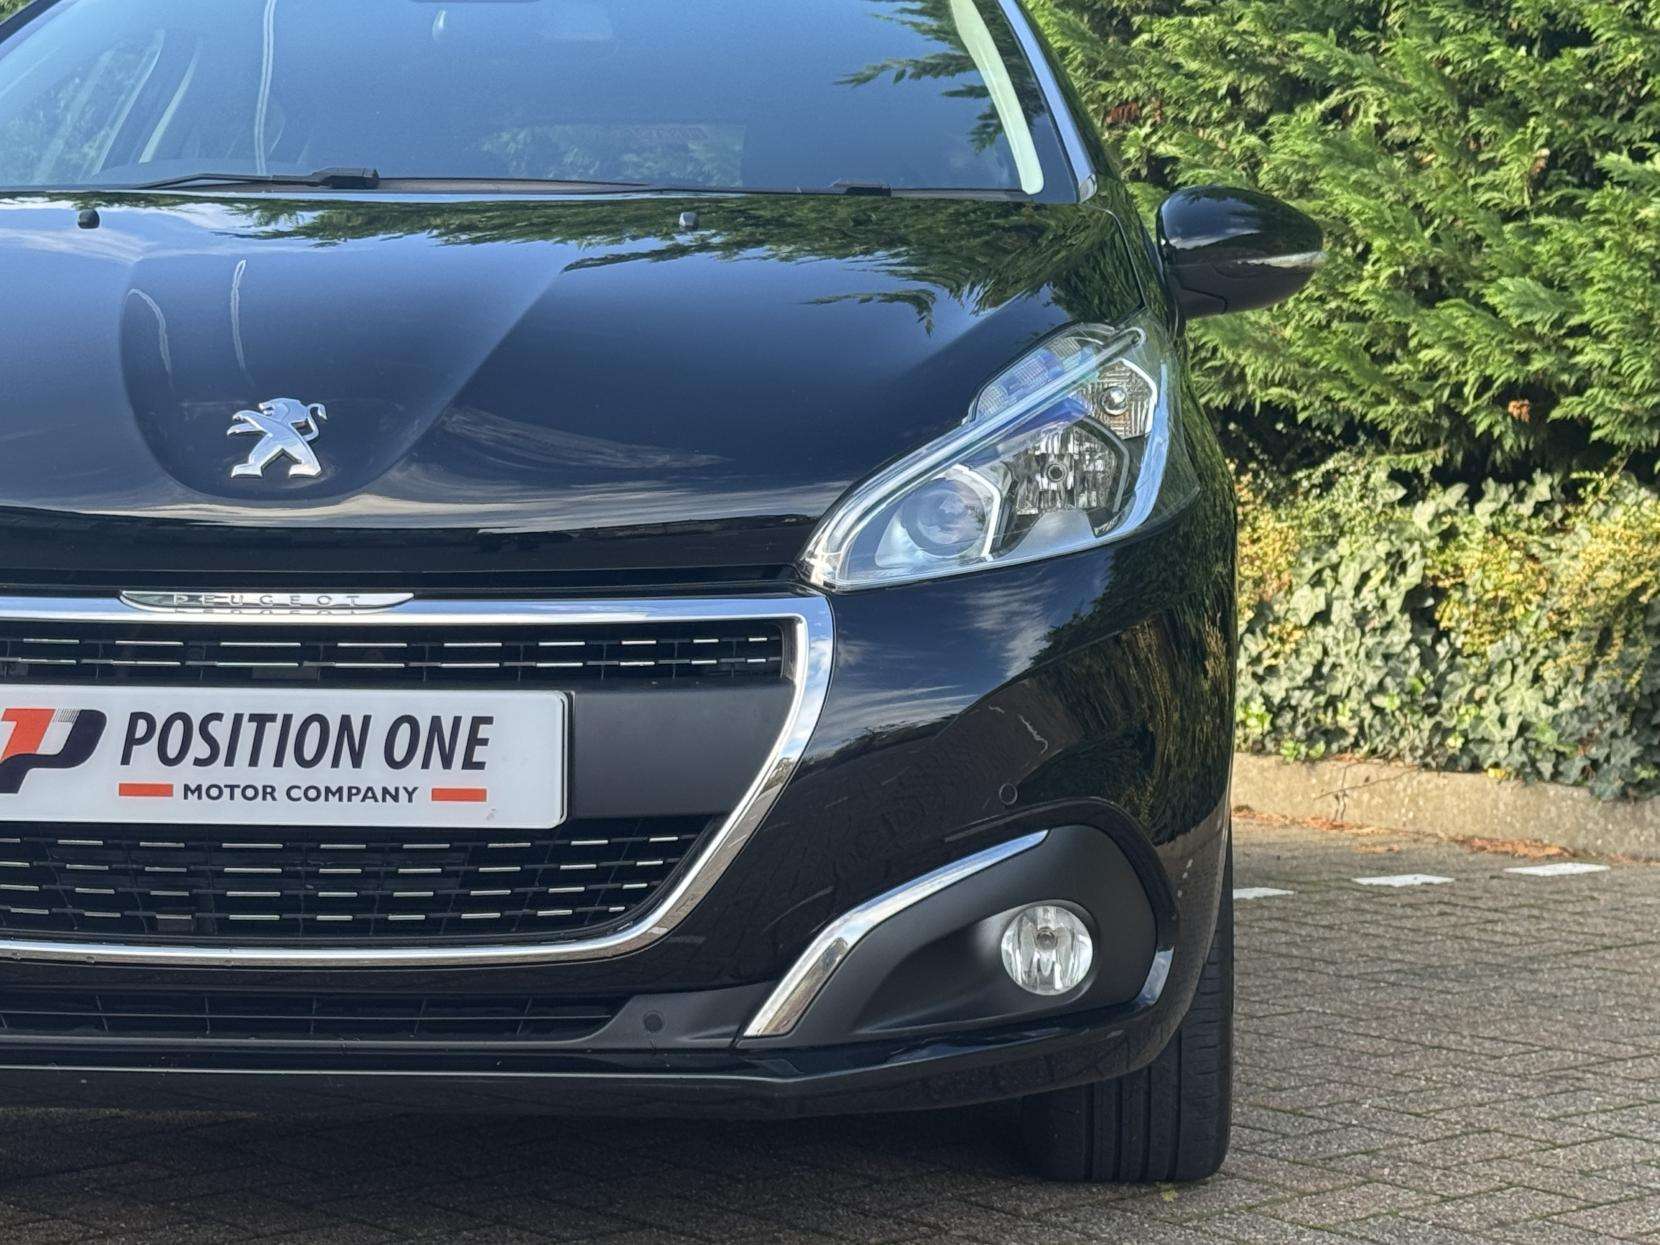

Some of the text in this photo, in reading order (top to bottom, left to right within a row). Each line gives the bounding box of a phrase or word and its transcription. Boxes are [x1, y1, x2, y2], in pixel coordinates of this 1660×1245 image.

[171, 593, 361, 606] PEUGEOT
[119, 711, 495, 770] POSITION ONE
[182, 783, 419, 804] MOTOR COMPANY
